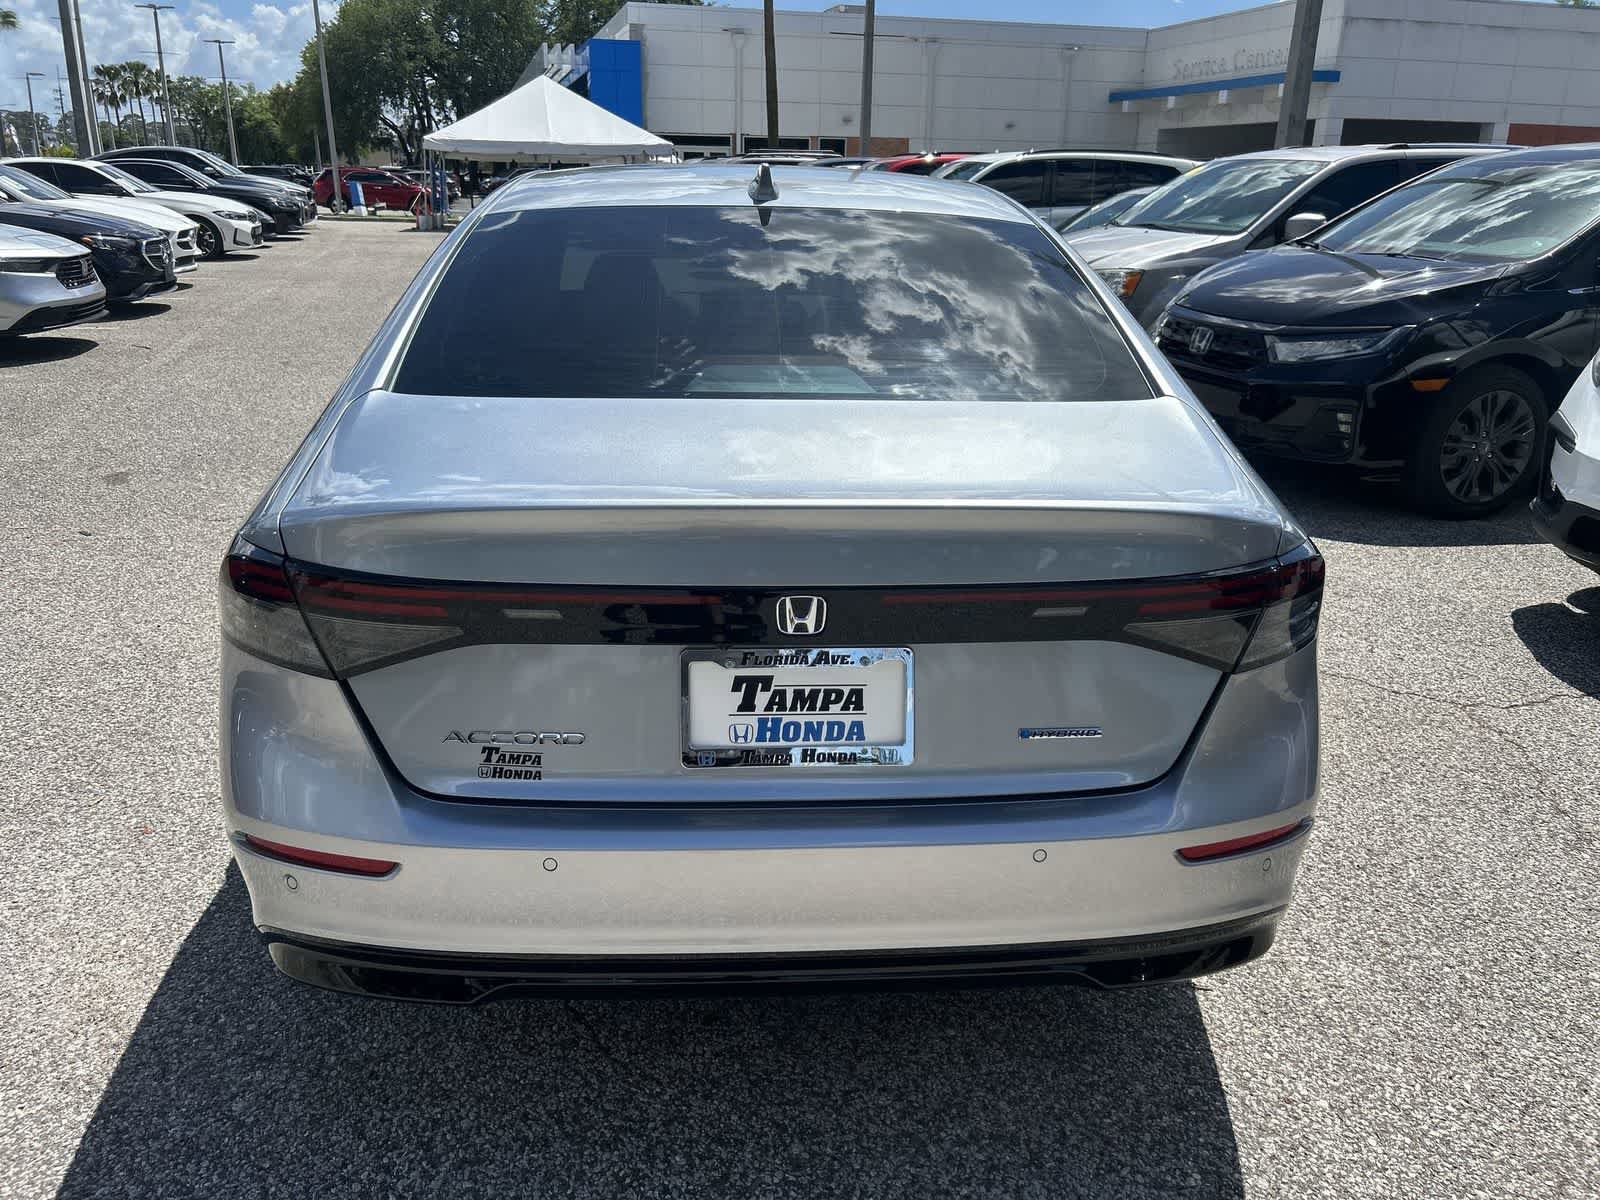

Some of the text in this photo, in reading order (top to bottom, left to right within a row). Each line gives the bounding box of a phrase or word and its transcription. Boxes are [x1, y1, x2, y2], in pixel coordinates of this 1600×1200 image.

[741, 650, 855, 666] FLORIDA AVE.
[731, 675, 865, 713] TAMPA
[441, 729, 586, 745] ACCORD
[755, 717, 866, 743] HONDA
[1029, 727, 1102, 739] HYBRID
[481, 746, 543, 766] TAMPA
[741, 748, 858, 765] TAMPA HONDA
[491, 766, 543, 781] HONDA
